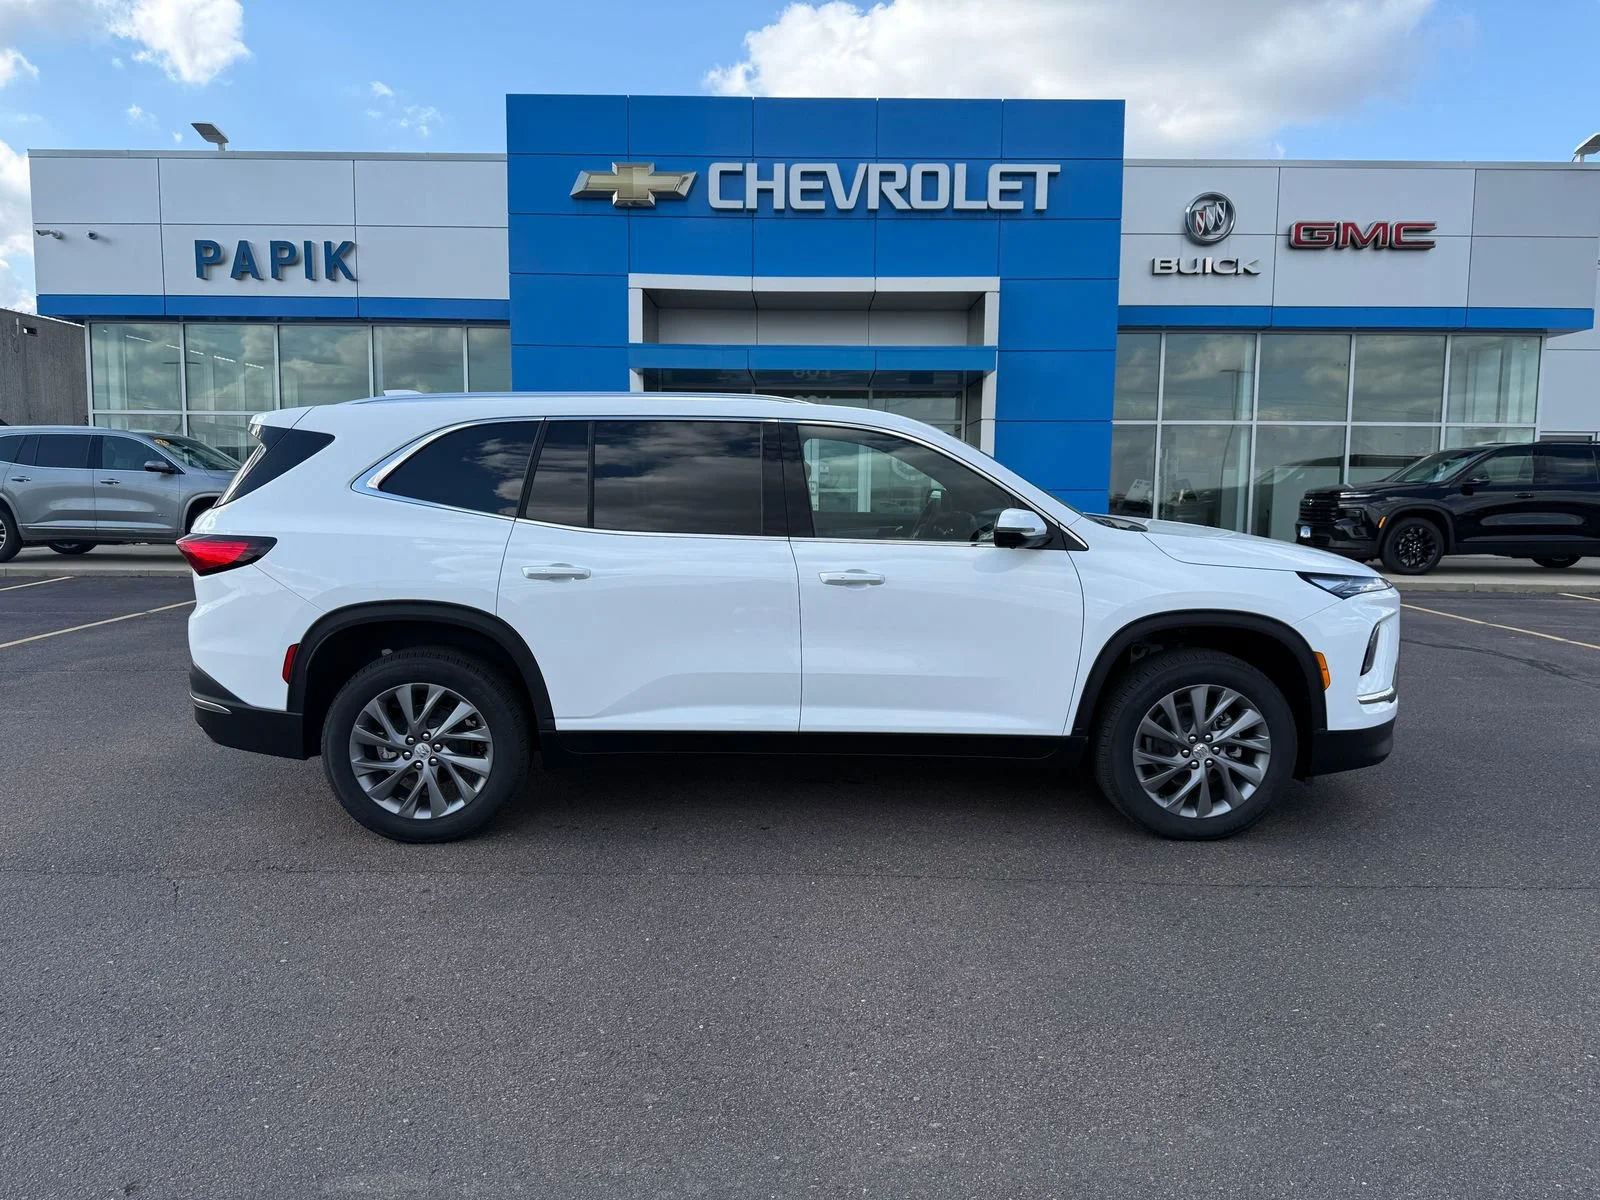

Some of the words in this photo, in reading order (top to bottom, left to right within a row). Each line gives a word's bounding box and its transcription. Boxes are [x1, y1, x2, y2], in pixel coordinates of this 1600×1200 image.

[708, 162, 1061, 210] CHEVROLET
[1290, 221, 1438, 249] GMC
[194, 239, 359, 281] PAPIK
[1152, 257, 1261, 275] BUICK
